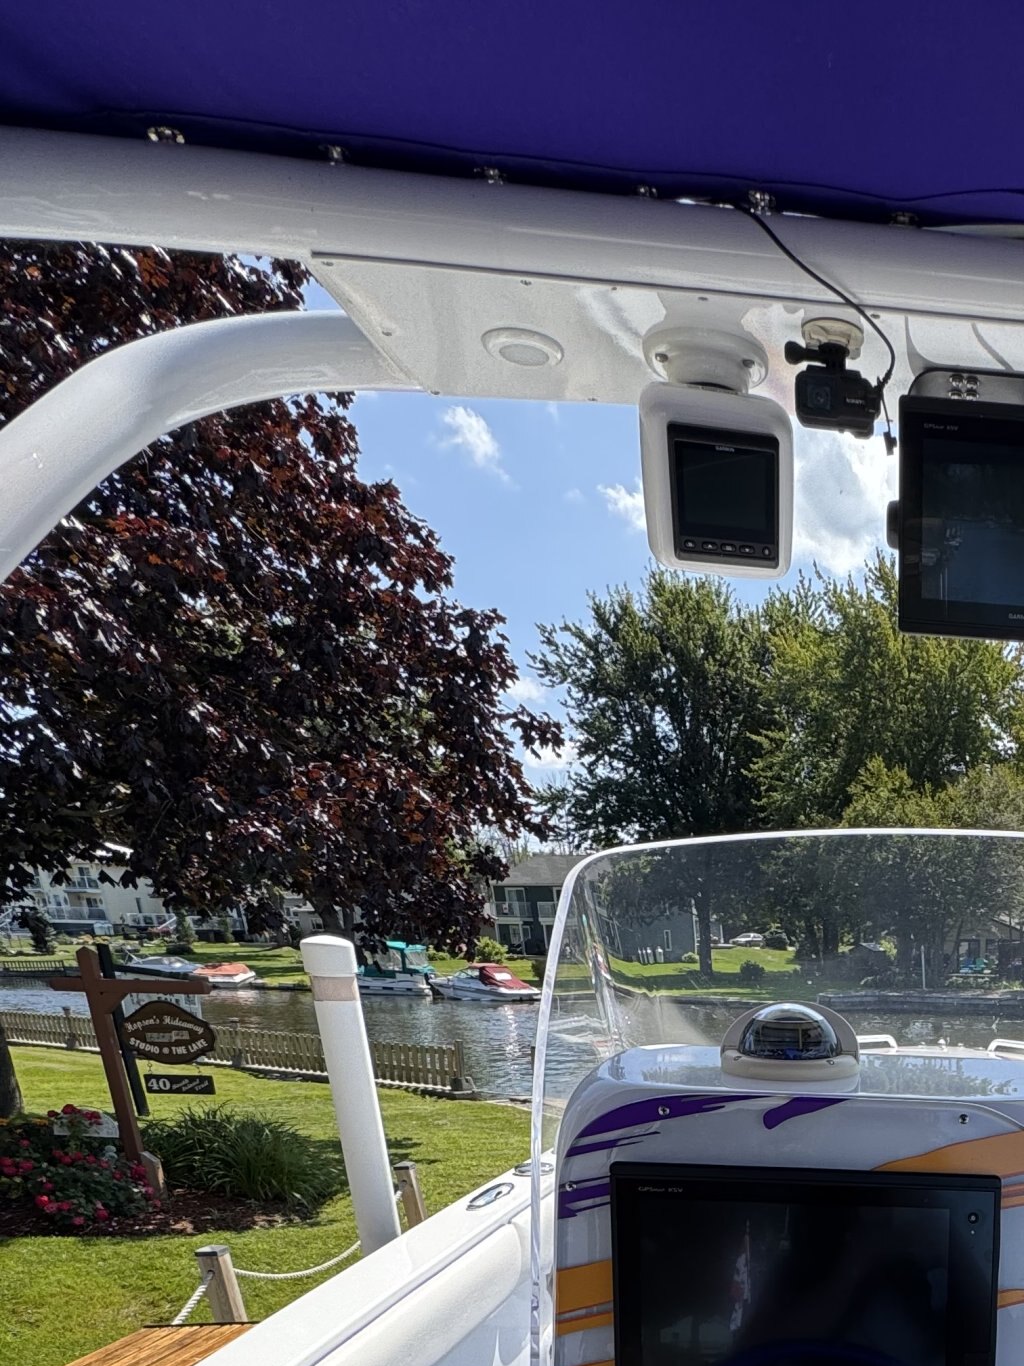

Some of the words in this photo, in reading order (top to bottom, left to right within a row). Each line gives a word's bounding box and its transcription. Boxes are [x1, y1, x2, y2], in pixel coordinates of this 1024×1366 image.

[129, 1037, 159, 1054] STUDIO
[171, 1046, 188, 1055] THE
[188, 1039, 208, 1053] LAKE
[147, 1078, 171, 1090] 40
